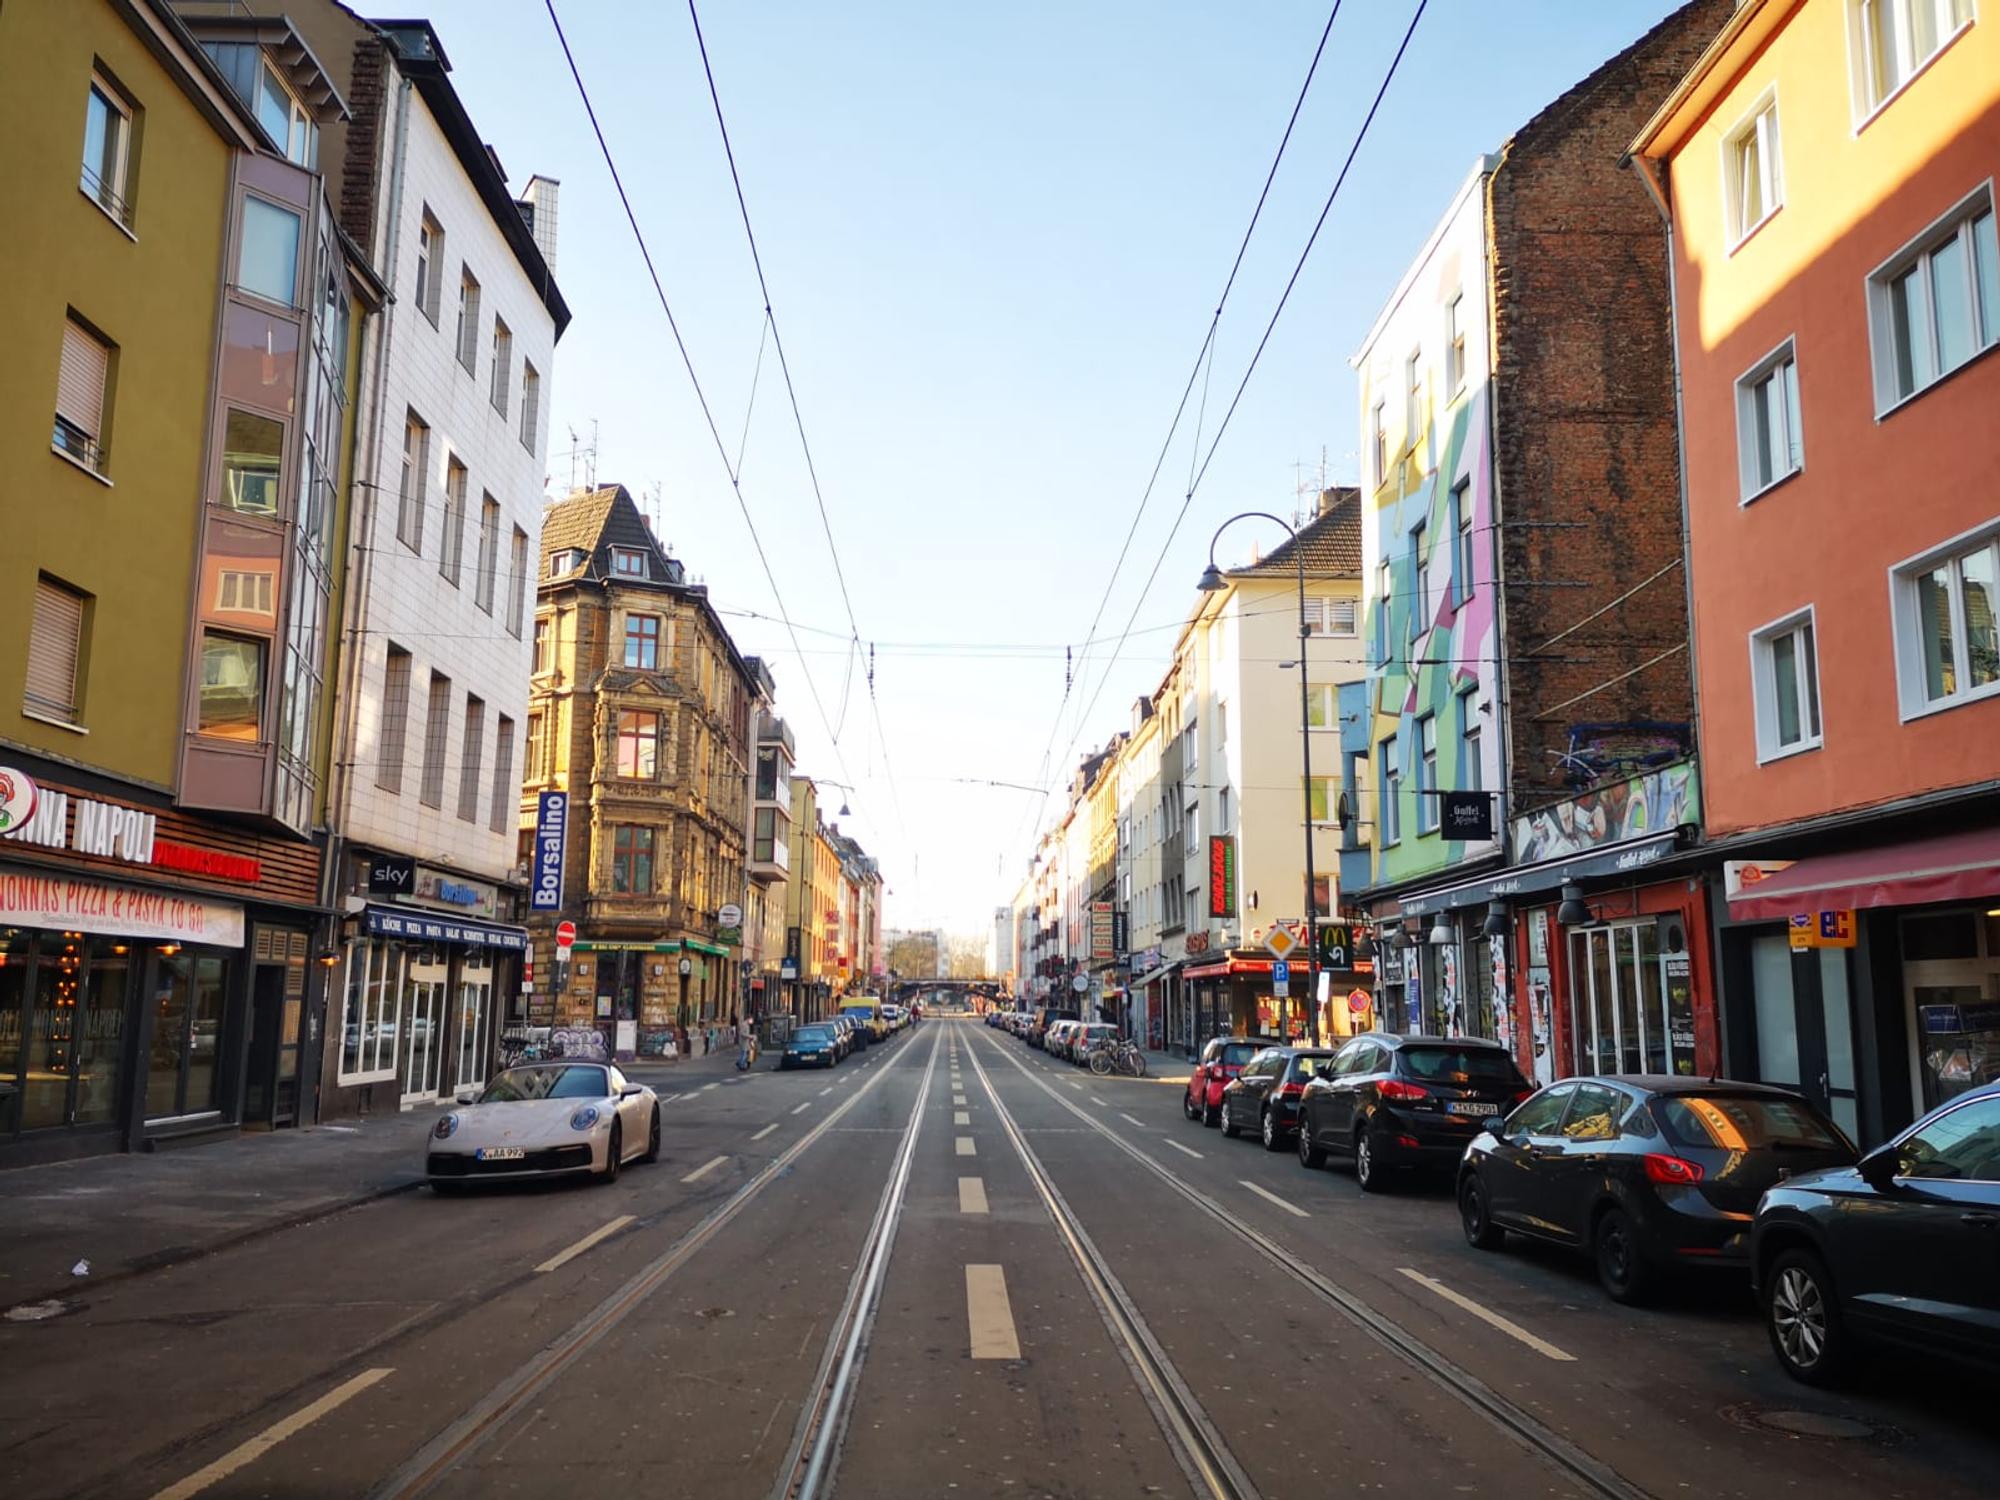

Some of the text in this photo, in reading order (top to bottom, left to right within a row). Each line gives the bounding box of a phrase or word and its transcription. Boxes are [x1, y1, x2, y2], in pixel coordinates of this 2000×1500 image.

[80, 798, 156, 864] NAPOLI
[534, 795, 564, 906] Borsalino
[374, 865, 409, 885] sky
[66, 880, 108, 917] PIZZA
[112, 886, 123, 919] &
[127, 889, 166, 928] PASTA
[171, 898, 184, 929] TO
[1276, 963, 1286, 980] P
